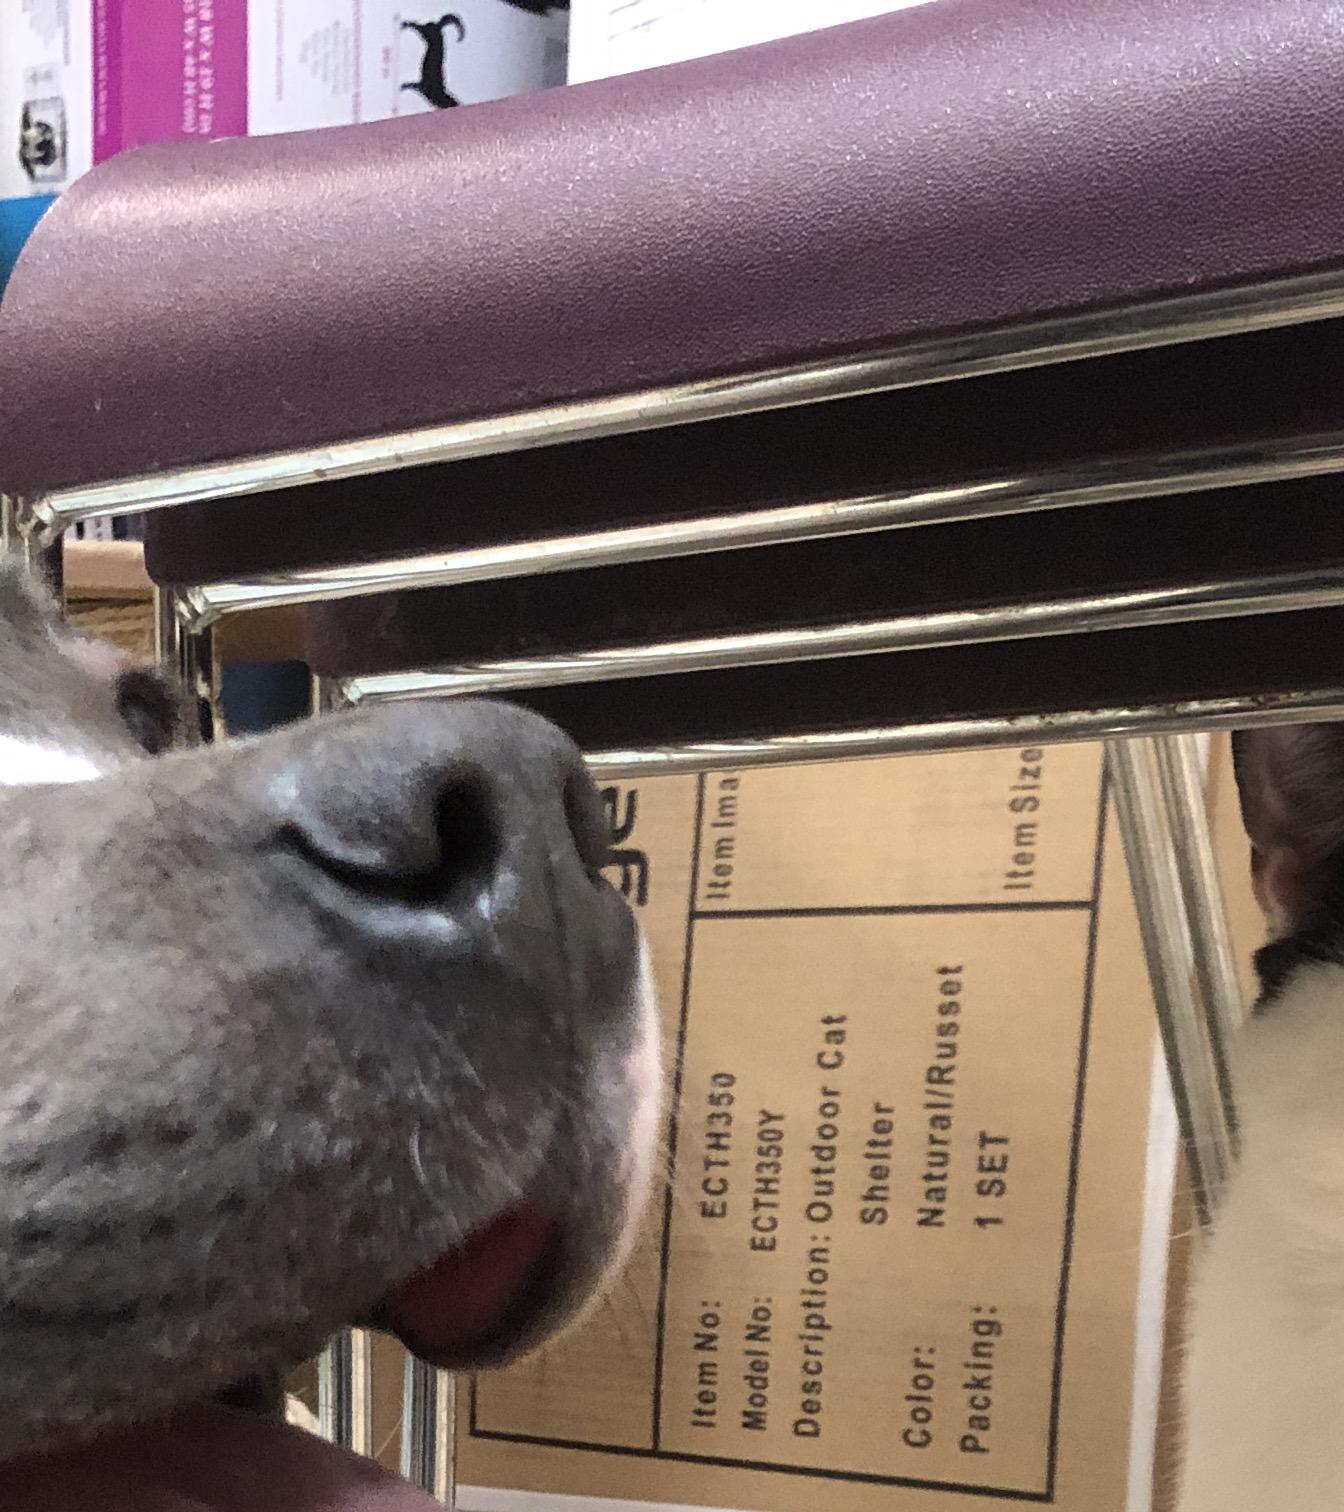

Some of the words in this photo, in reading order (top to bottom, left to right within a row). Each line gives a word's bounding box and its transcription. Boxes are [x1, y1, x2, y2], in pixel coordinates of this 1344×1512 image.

[706, 837, 734, 900] Item
[1004, 819, 1036, 892] Item
[817, 1012, 848, 1071] Cat
[917, 964, 965, 1228] Natural/Russet
[700, 1070, 738, 1220] ECTH350
[750, 1109, 787, 1253] ECTH350Y
[805, 1084, 844, 1223] Outdoor
[860, 1101, 896, 1226] Shelter
[978, 1131, 1011, 1200] SET
[976, 1213, 1003, 1230] 1
[697, 1299, 722, 1354] No:
[748, 1296, 774, 1345] No:
[793, 1231, 833, 1440] Description:
[691, 1361, 720, 1430] Item
[742, 1347, 771, 1431] Model
[903, 1345, 939, 1449] Color:
[961, 1303, 1001, 1455] Packing:
